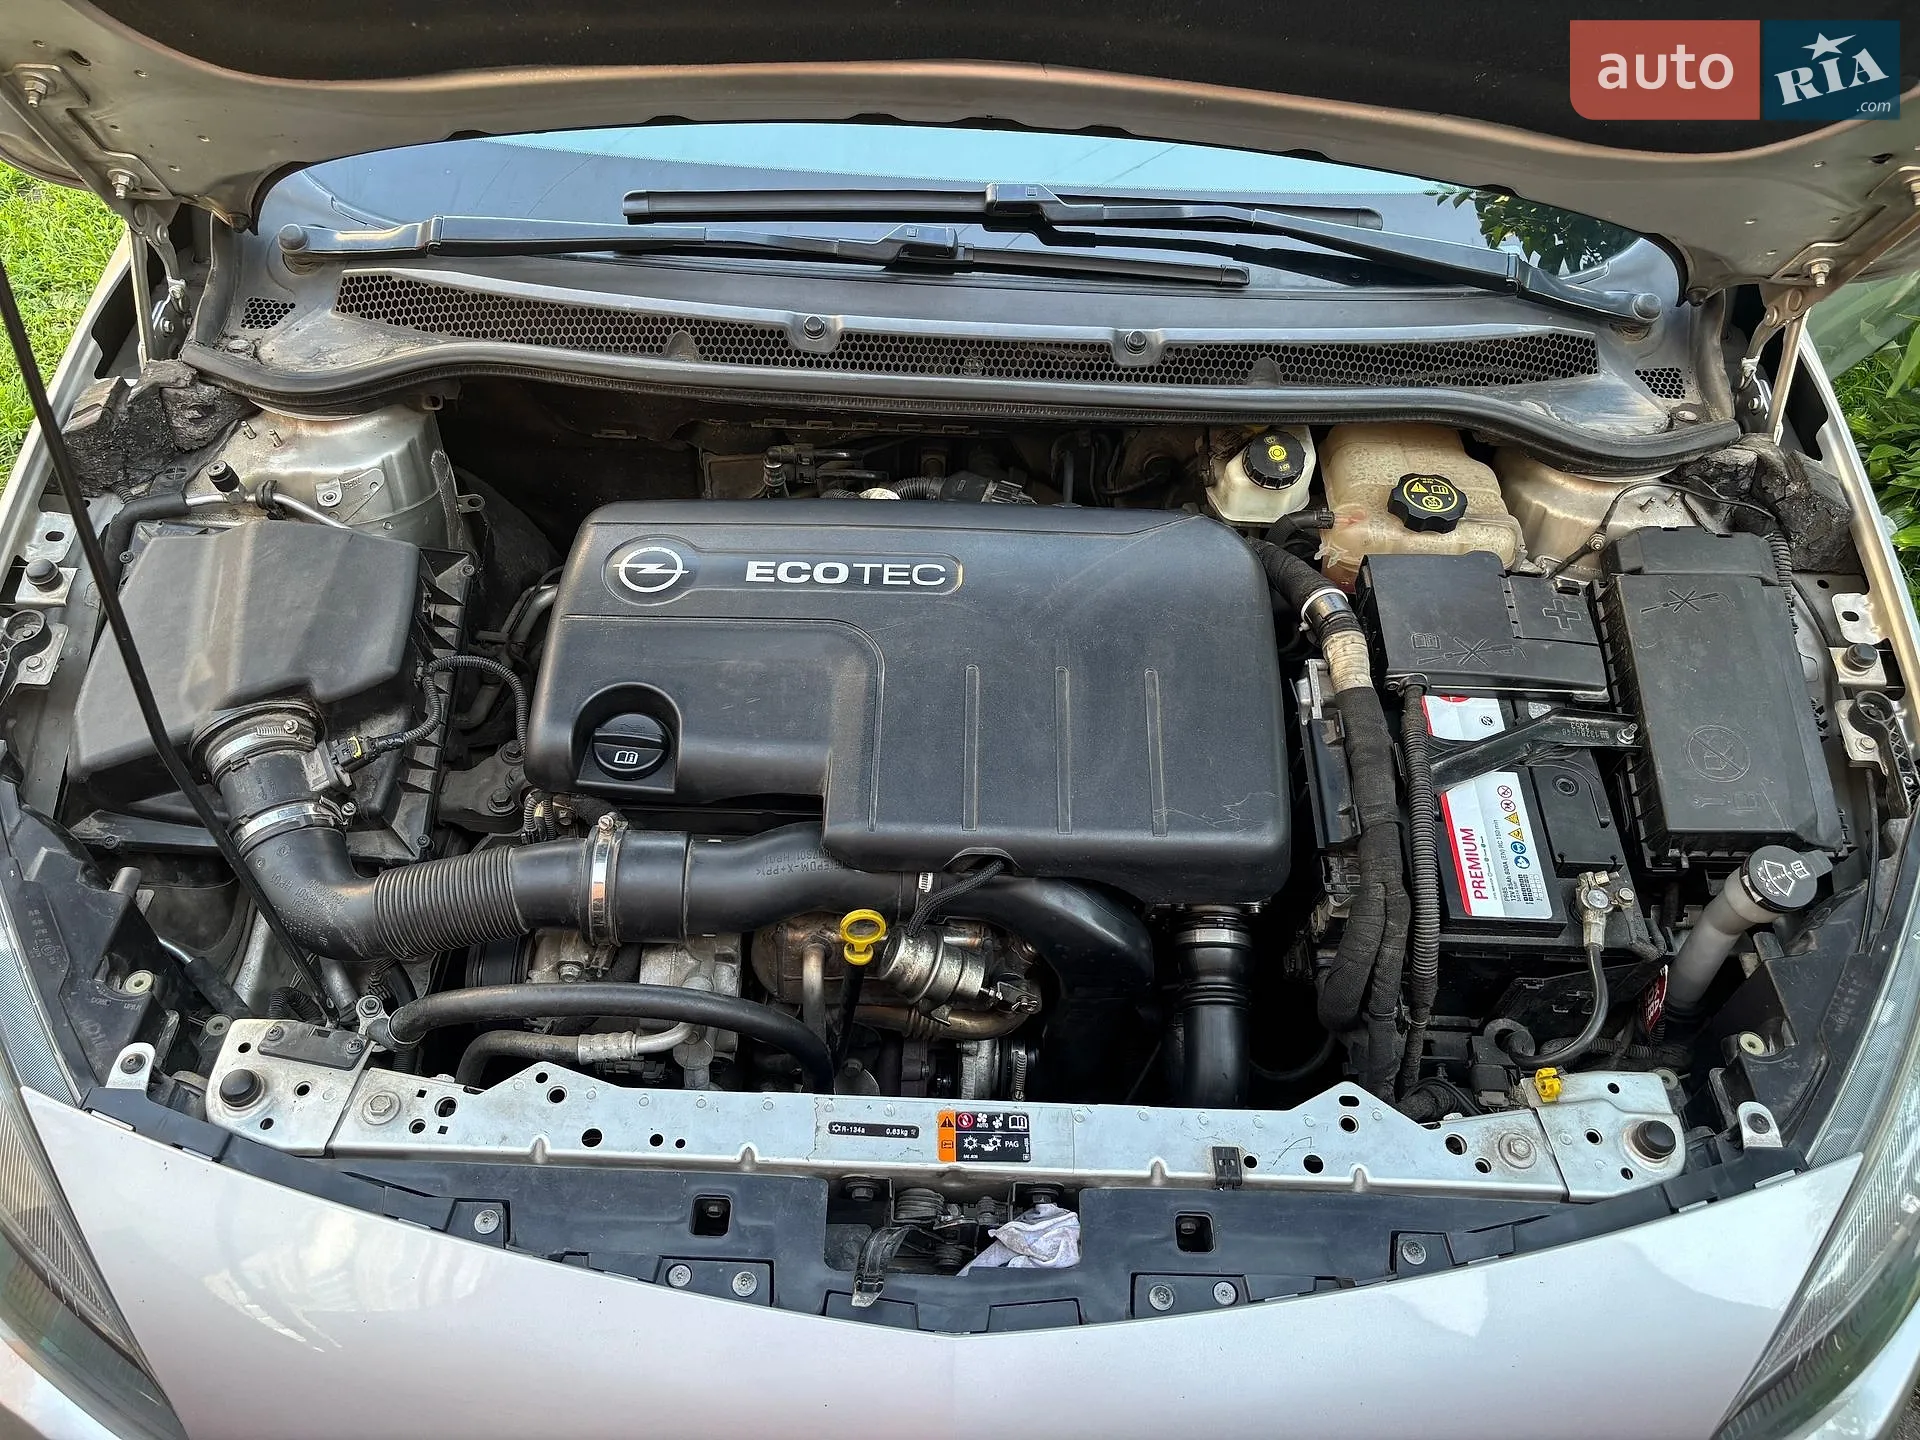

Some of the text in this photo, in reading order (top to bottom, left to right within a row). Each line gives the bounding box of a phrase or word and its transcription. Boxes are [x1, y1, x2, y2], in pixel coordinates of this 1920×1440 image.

[745, 560, 946, 586] ECOTEC
[1460, 827, 1488, 900] PREMIUM
[1004, 1140, 1019, 1148] PAG
